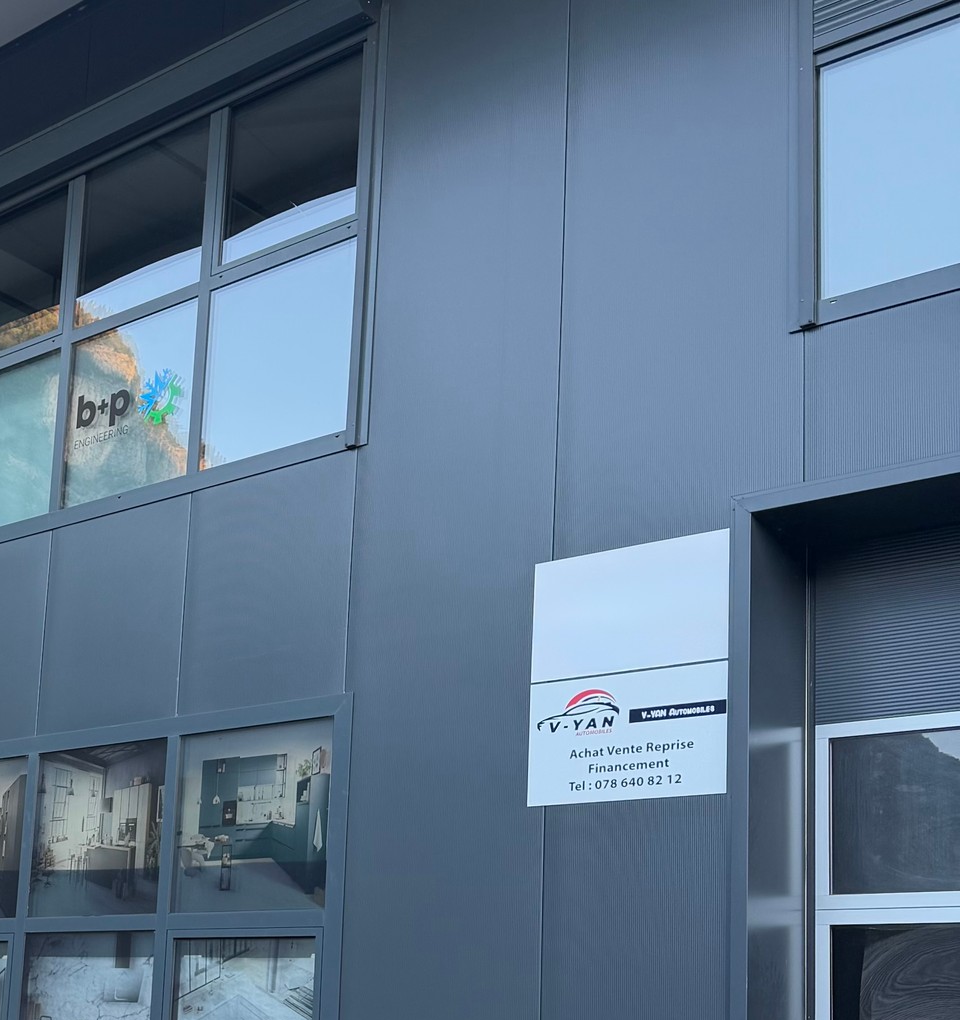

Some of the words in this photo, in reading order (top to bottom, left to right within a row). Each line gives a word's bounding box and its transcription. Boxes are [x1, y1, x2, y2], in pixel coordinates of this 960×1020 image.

[76, 389, 130, 429] b+p
[73, 425, 129, 450] ENGINEERING
[641, 709, 667, 719] V-YAN
[549, 716, 614, 733] V-YAN
[575, 728, 612, 736] AUTOMOBILES
[569, 748, 604, 759] Achat
[607, 745, 643, 756] Vente
[646, 739, 694, 753] Reprise
[588, 758, 669, 774] Financement
[595, 778, 617, 789] 078
[621, 776, 644, 788] 640
[647, 775, 662, 786] 82
[667, 773, 682, 784] 12
